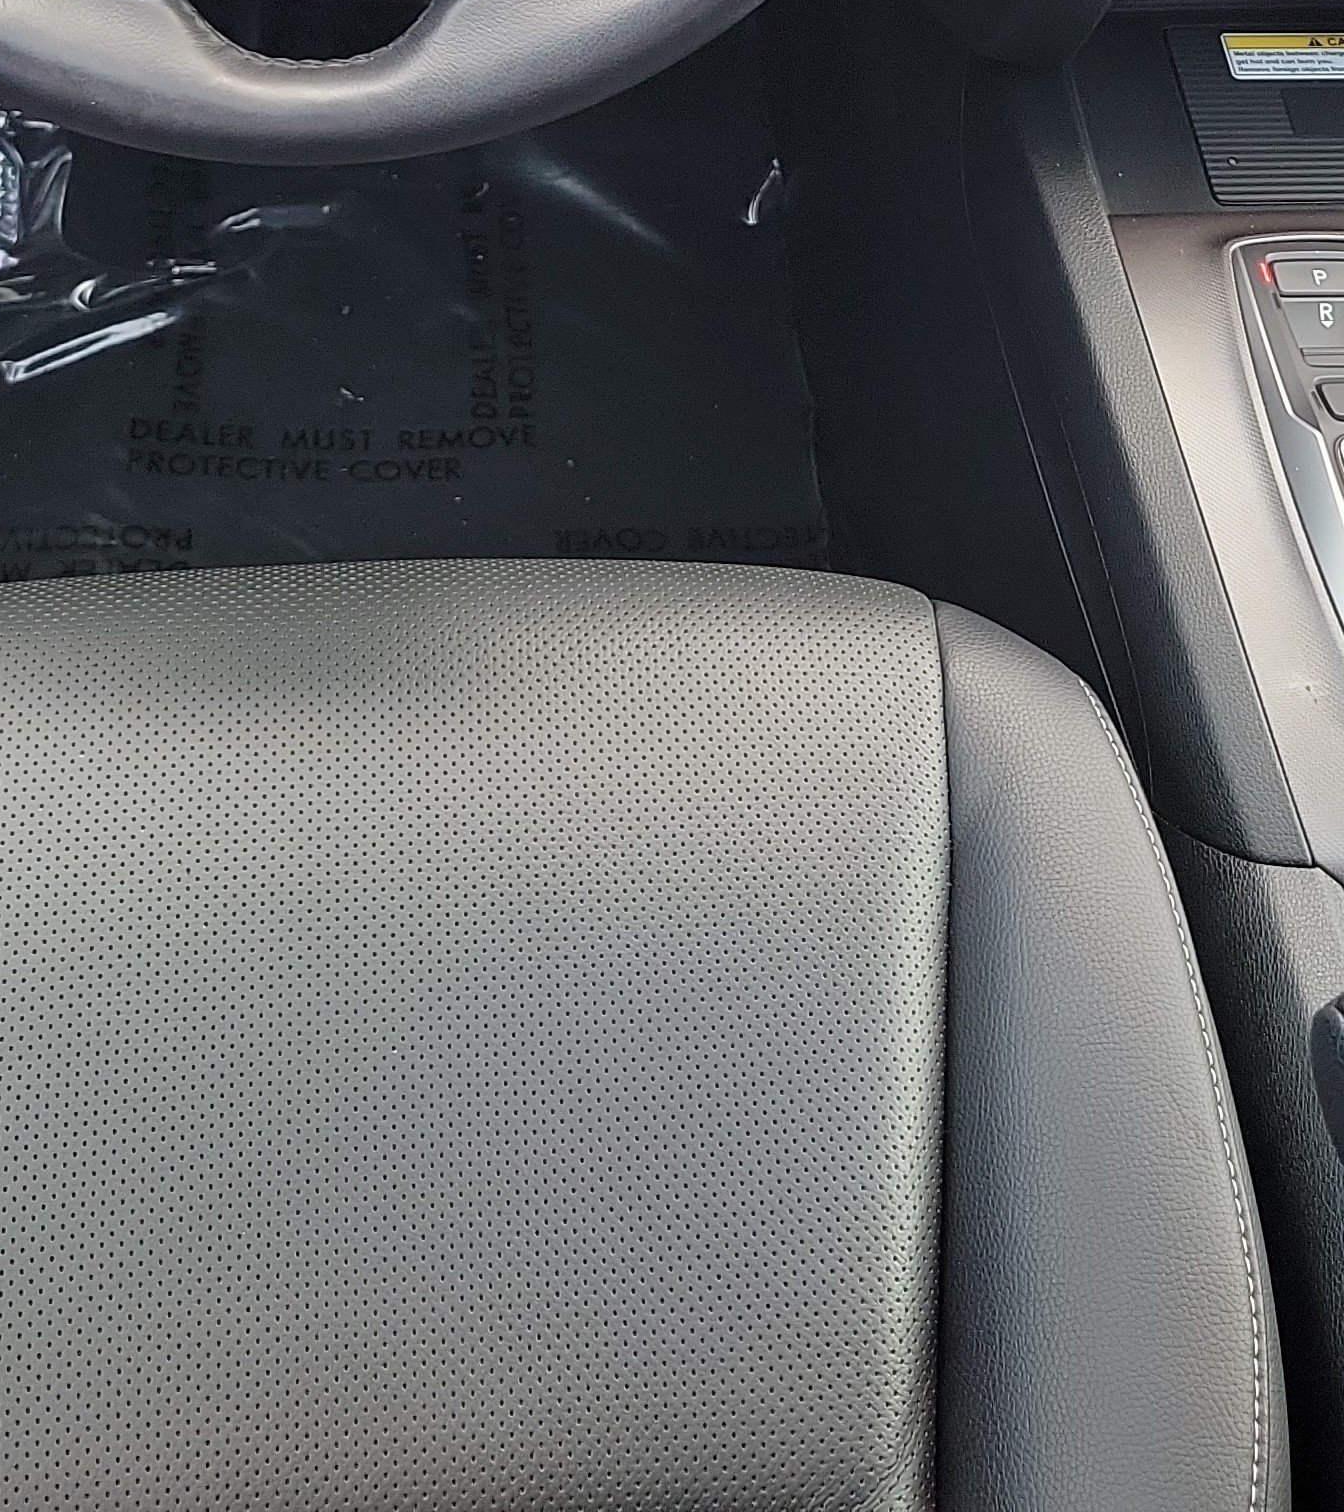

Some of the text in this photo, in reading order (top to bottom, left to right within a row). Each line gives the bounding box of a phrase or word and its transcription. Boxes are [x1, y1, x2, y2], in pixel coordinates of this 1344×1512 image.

[1312, 269, 1327, 286] P
[1318, 302, 1334, 322] R
[130, 418, 537, 450] DEALER MUST REMOVE
[129, 450, 464, 482] PROTECTIVE COVER
